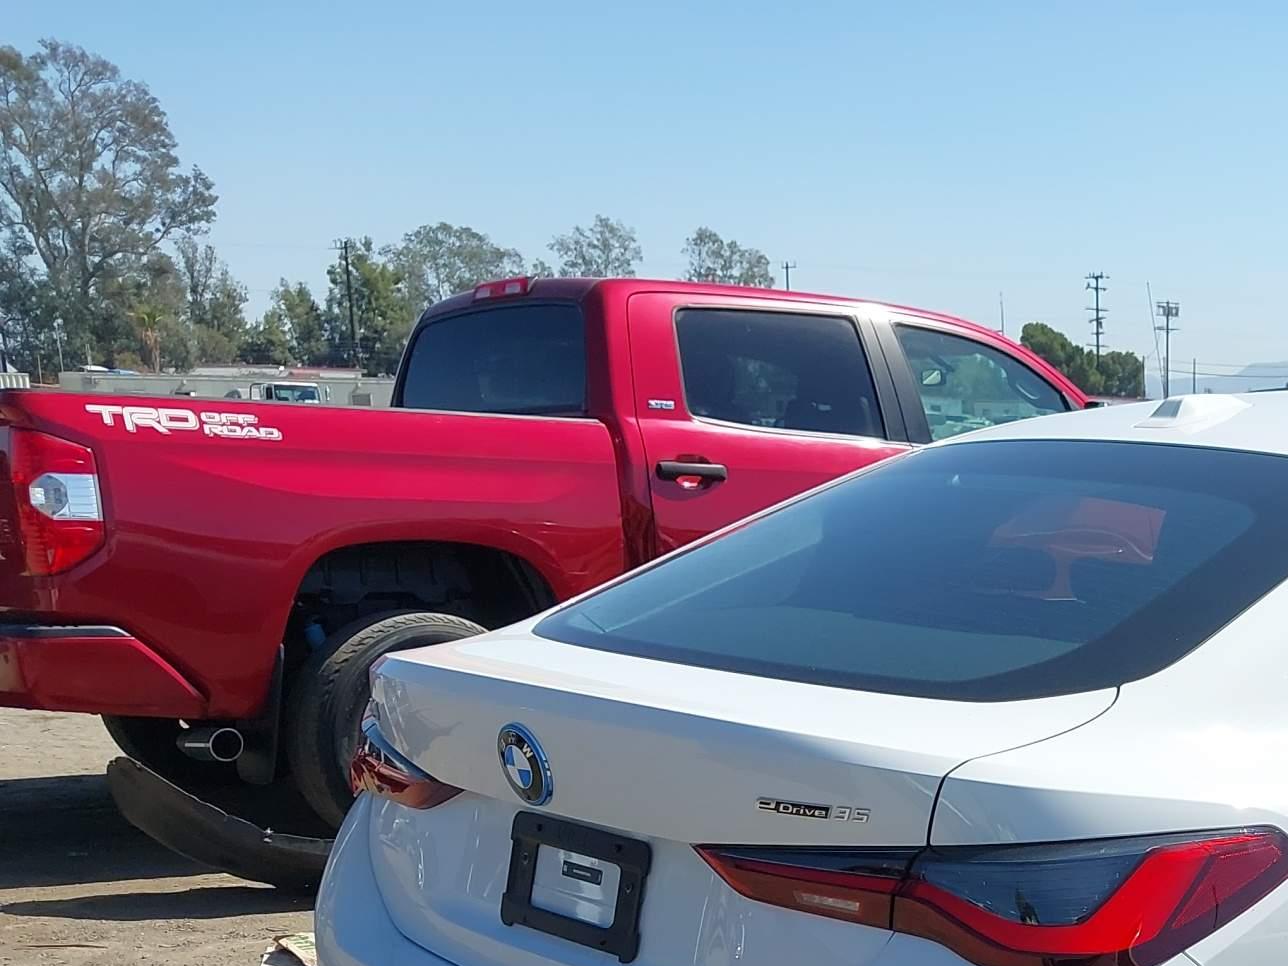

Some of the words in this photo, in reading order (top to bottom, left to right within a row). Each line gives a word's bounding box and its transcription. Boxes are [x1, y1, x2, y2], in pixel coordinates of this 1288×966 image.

[85, 404, 200, 435] TRD
[200, 412, 258, 424] OFF
[203, 424, 283, 441] ROAD
[833, 805, 871, 823] 35
